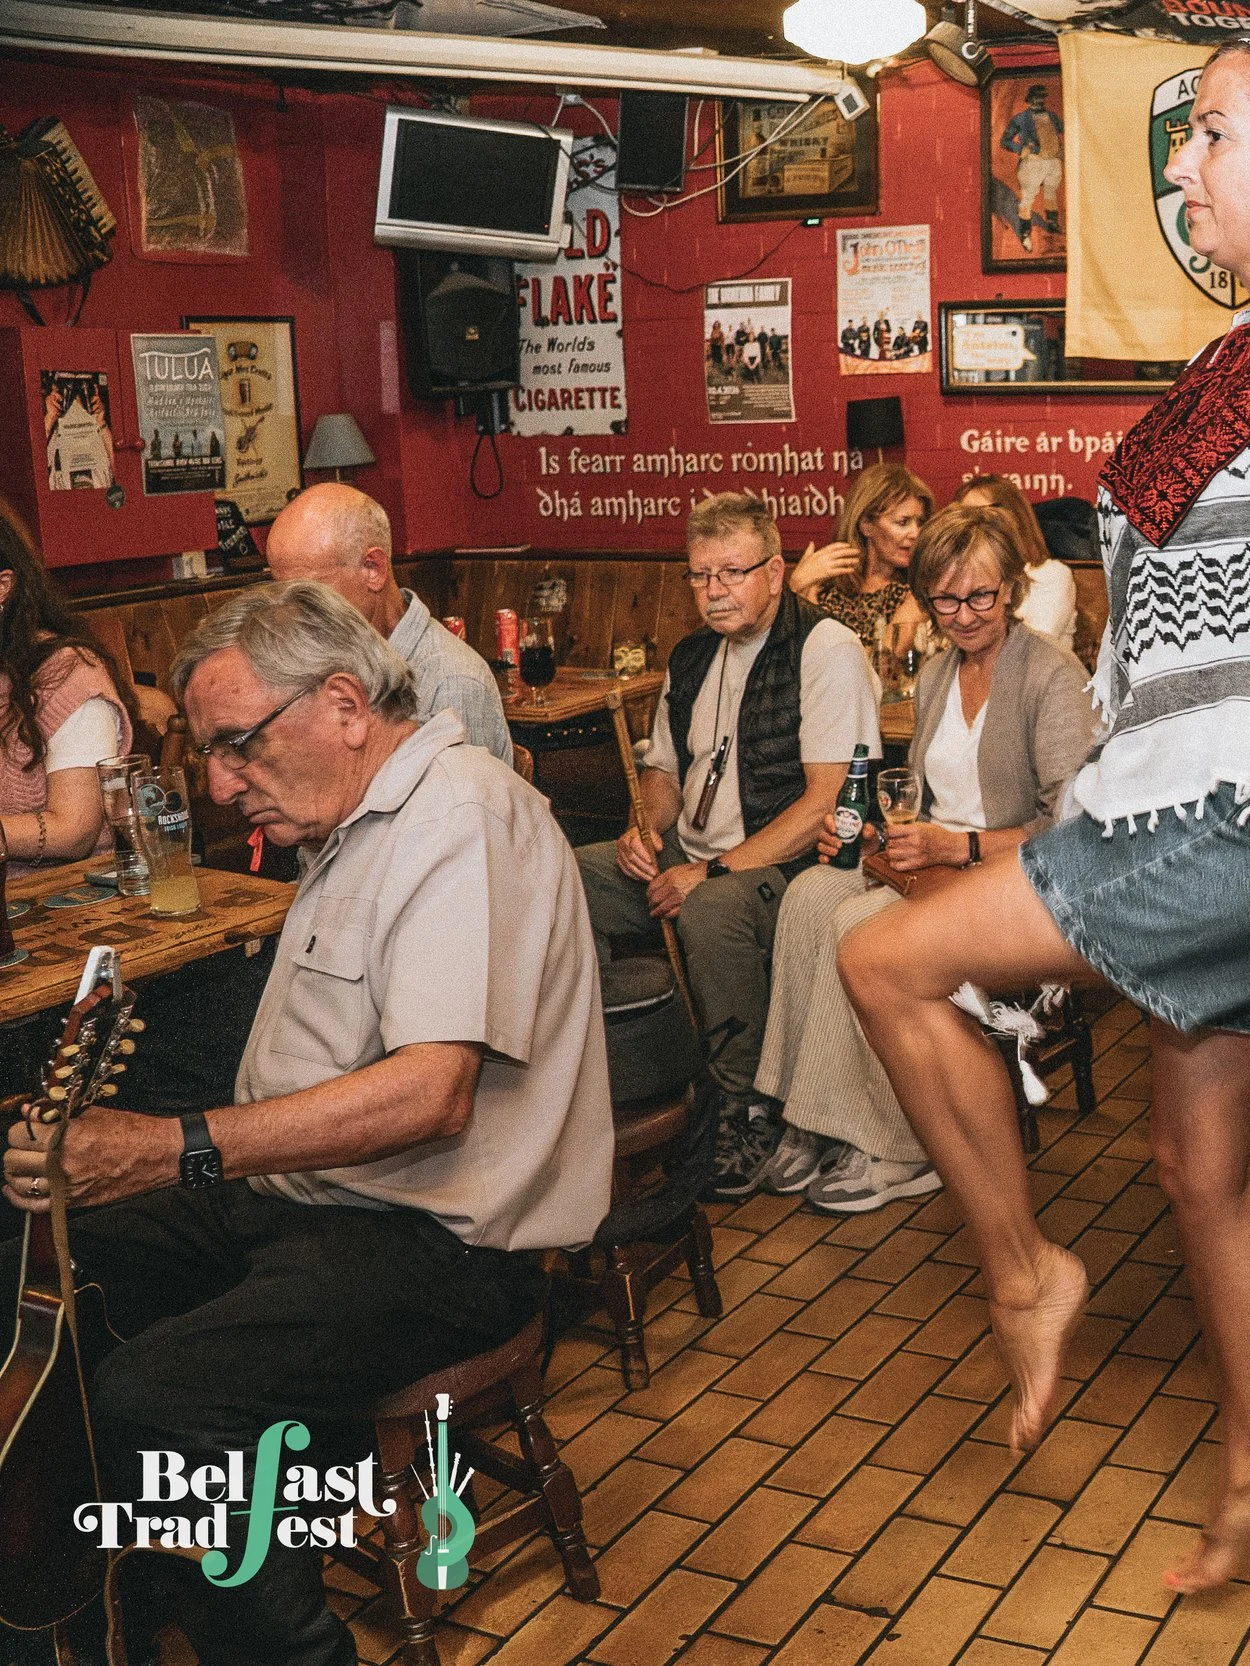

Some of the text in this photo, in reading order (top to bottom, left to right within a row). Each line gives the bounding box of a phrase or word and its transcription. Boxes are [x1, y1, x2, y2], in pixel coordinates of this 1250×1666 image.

[564, 208, 613, 261] LD
[519, 339, 541, 354] The
[139, 347, 214, 381] TULUA
[532, 359, 562, 375] most
[512, 385, 621, 412] CIGARETTE
[960, 429, 1029, 453] Gáire
[1035, 431, 1063, 453] ár
[539, 446, 560, 475] Is
[568, 446, 626, 475] fearr
[632, 447, 724, 478] amharc
[590, 489, 681, 524] amharc
